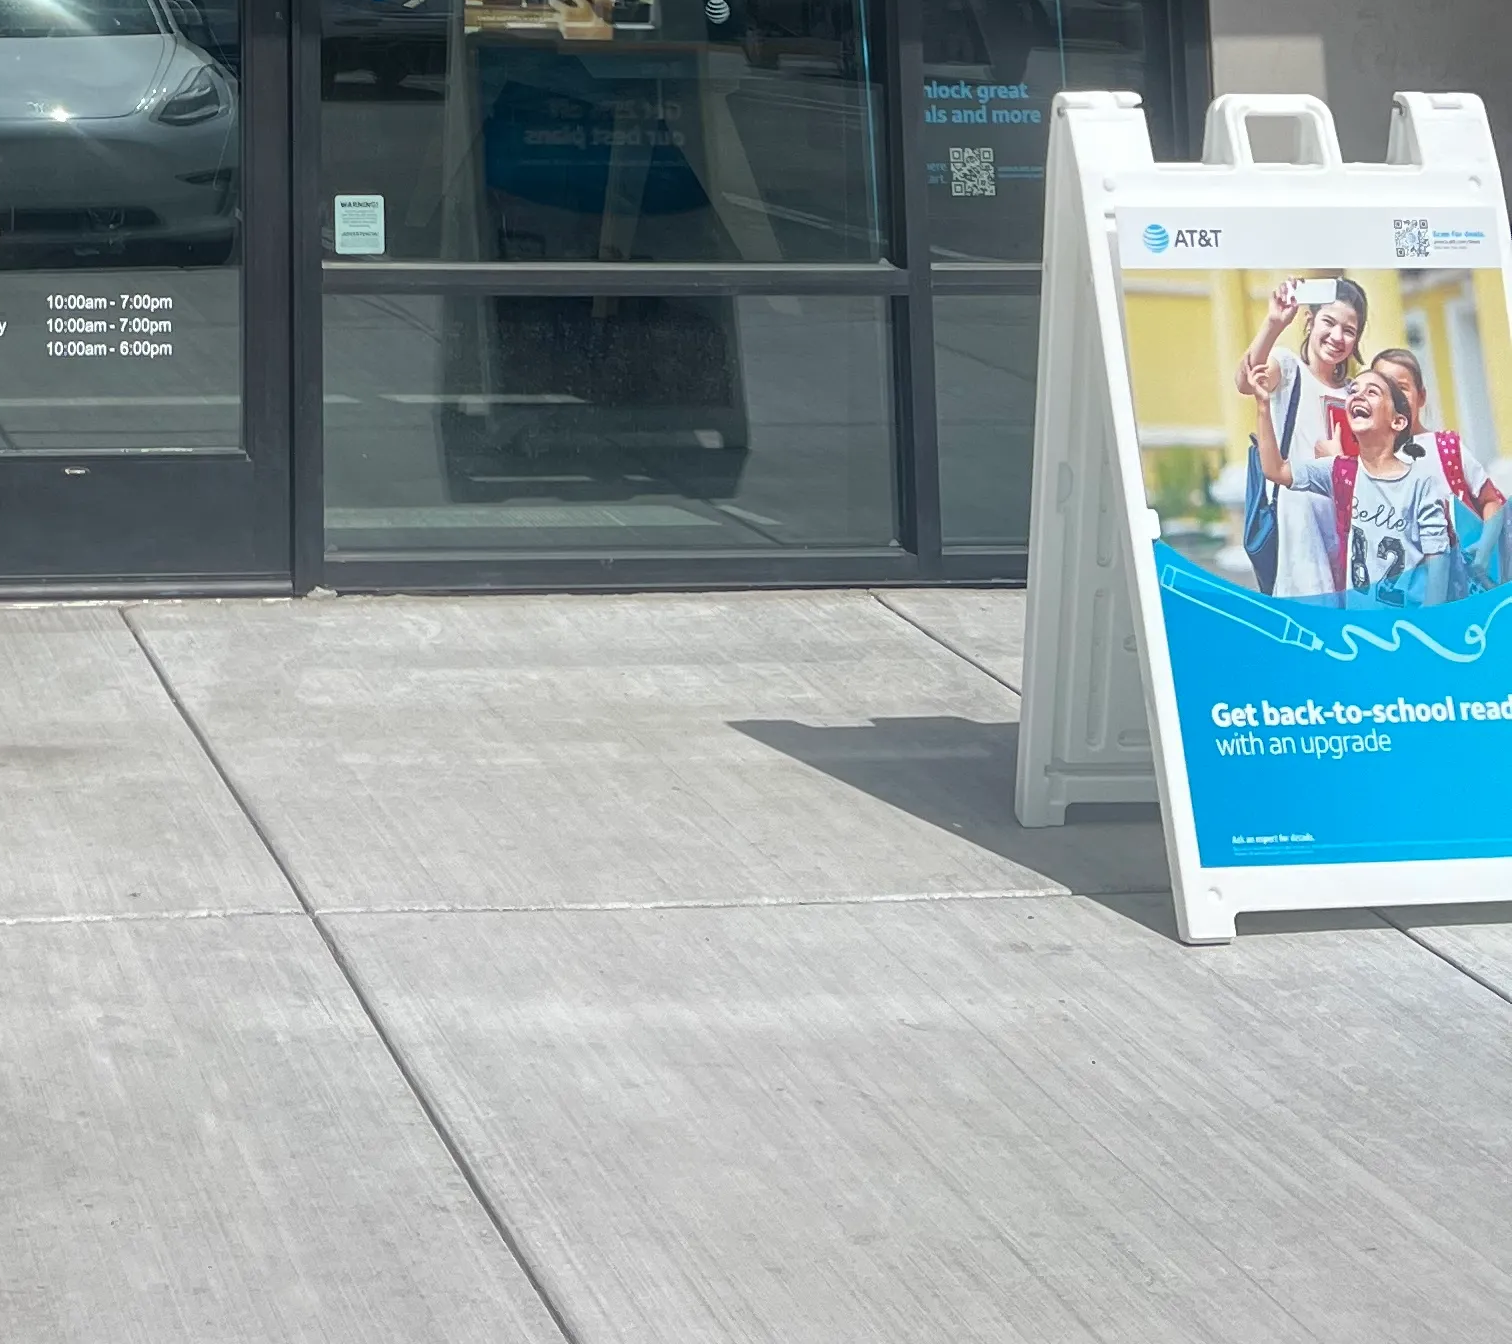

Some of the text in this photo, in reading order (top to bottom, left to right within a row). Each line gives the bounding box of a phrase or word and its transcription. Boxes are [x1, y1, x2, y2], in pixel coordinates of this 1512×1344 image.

[976, 82, 1029, 104] great
[951, 104, 988, 123] and
[992, 108, 1041, 123] more
[1175, 229, 1222, 249] AT&T
[46, 294, 107, 310] 10:00am
[119, 294, 173, 312] 7:00pm
[46, 318, 107, 333] 10:00am
[119, 317, 172, 336] 7:00pm
[46, 340, 107, 356] 10:00am
[119, 340, 173, 359] 6:00pm
[1211, 701, 1260, 729] Get
[1262, 695, 1455, 727] back-to-school
[1216, 728, 1392, 760] with an upgrade
